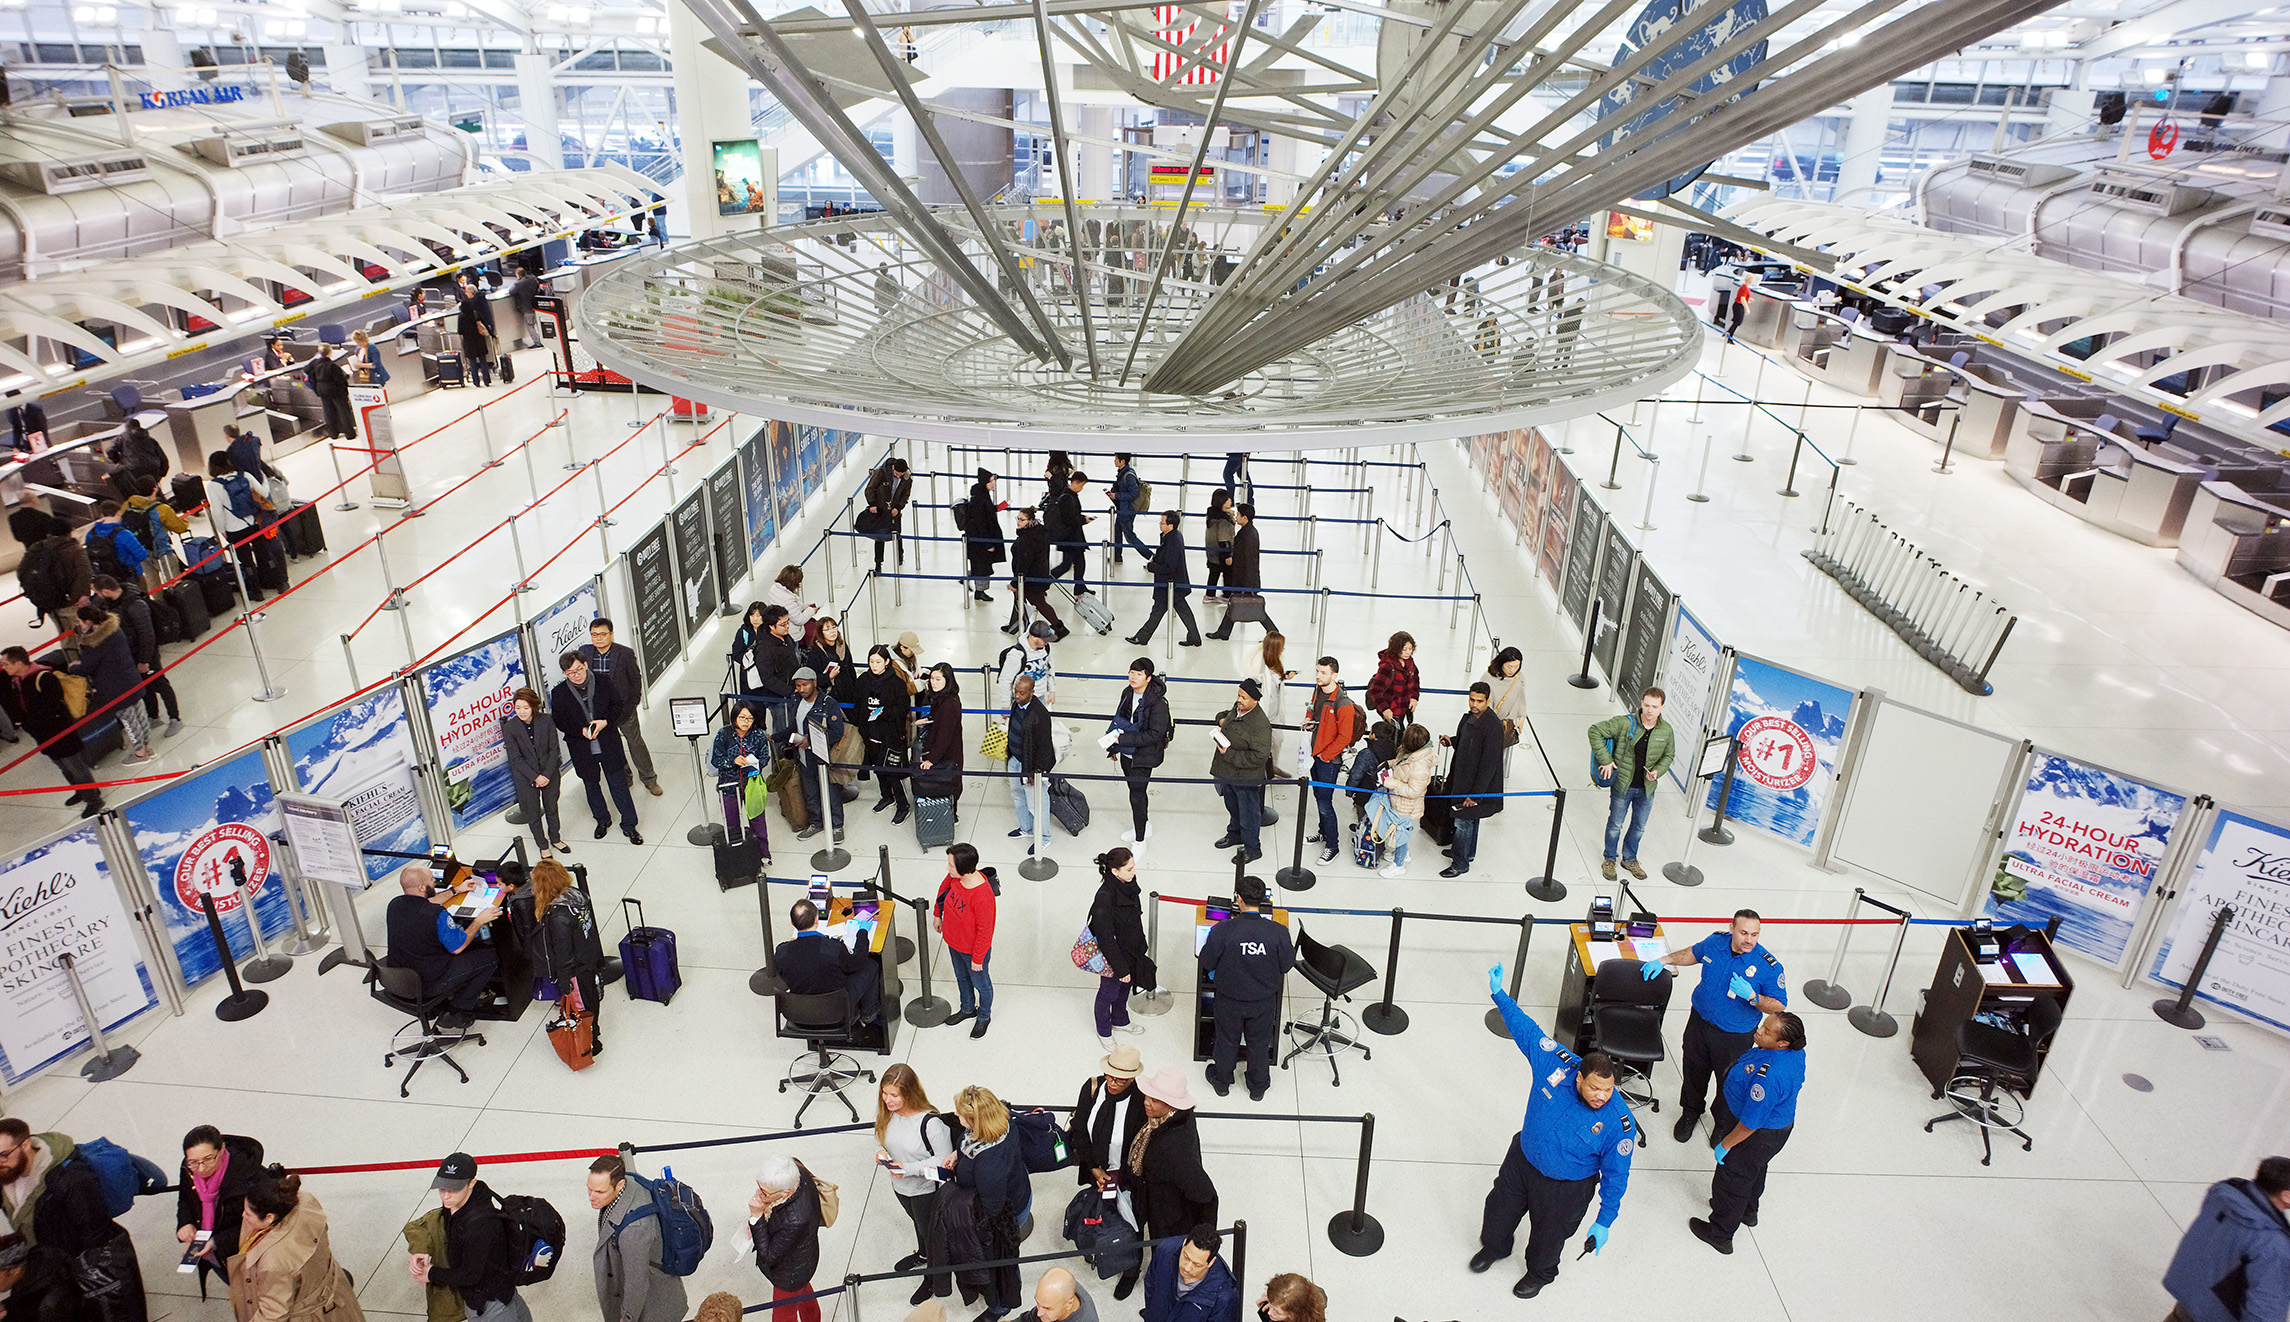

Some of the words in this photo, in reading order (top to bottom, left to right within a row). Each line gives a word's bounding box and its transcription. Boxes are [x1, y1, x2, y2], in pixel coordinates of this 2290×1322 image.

[139, 89, 211, 109] KOREAN
[214, 86, 244, 103] AIR
[642, 544, 651, 560] DUTY
[650, 536, 660, 552] FREE
[551, 615, 588, 653] Kiehl's
[1680, 635, 1707, 674] Kiehl's
[1669, 674, 1703, 718] APOTHECARY
[1679, 670, 1697, 698] FINEST
[440, 702, 514, 746] HYDRATIO
[448, 686, 512, 726] 24-HOUR
[1670, 687, 1695, 726] SKINCARE
[1744, 722, 1762, 738] OUR
[1762, 719, 1786, 729] BEST
[1786, 725, 1813, 759] SELLING
[1756, 737, 1794, 771] #1
[452, 760, 476, 777] ULTRA
[477, 746, 501, 764] FACIAL
[1742, 756, 1802, 786] MOISTURIZER
[355, 799, 382, 816] FACIAL
[383, 785, 405, 802] CREAM
[2018, 821, 2151, 876] HYDRATION
[2039, 811, 2139, 854] 24-HOUR
[180, 856, 196, 882] OUR
[191, 832, 217, 856] BEST
[219, 827, 261, 846] SELLING
[2233, 847, 2290, 882] Kie
[194, 868, 265, 909] MISTUIZER
[2012, 861, 2045, 878] ULTRA
[2048, 872, 2086, 892] FACIAL
[2088, 888, 2130, 908] CREAM
[2247, 881, 2280, 894] SINCE
[2201, 893, 2290, 933] APOTHEC
[2235, 890, 2290, 918] FINES
[0, 915, 111, 979] POTHECARY
[5, 918, 39, 938] SINCE
[7, 915, 77, 957] FINEST
[1240, 941, 1267, 956] TSA
[2221, 985, 2236, 996] DUTY
[2234, 989, 2249, 1001] FREE
